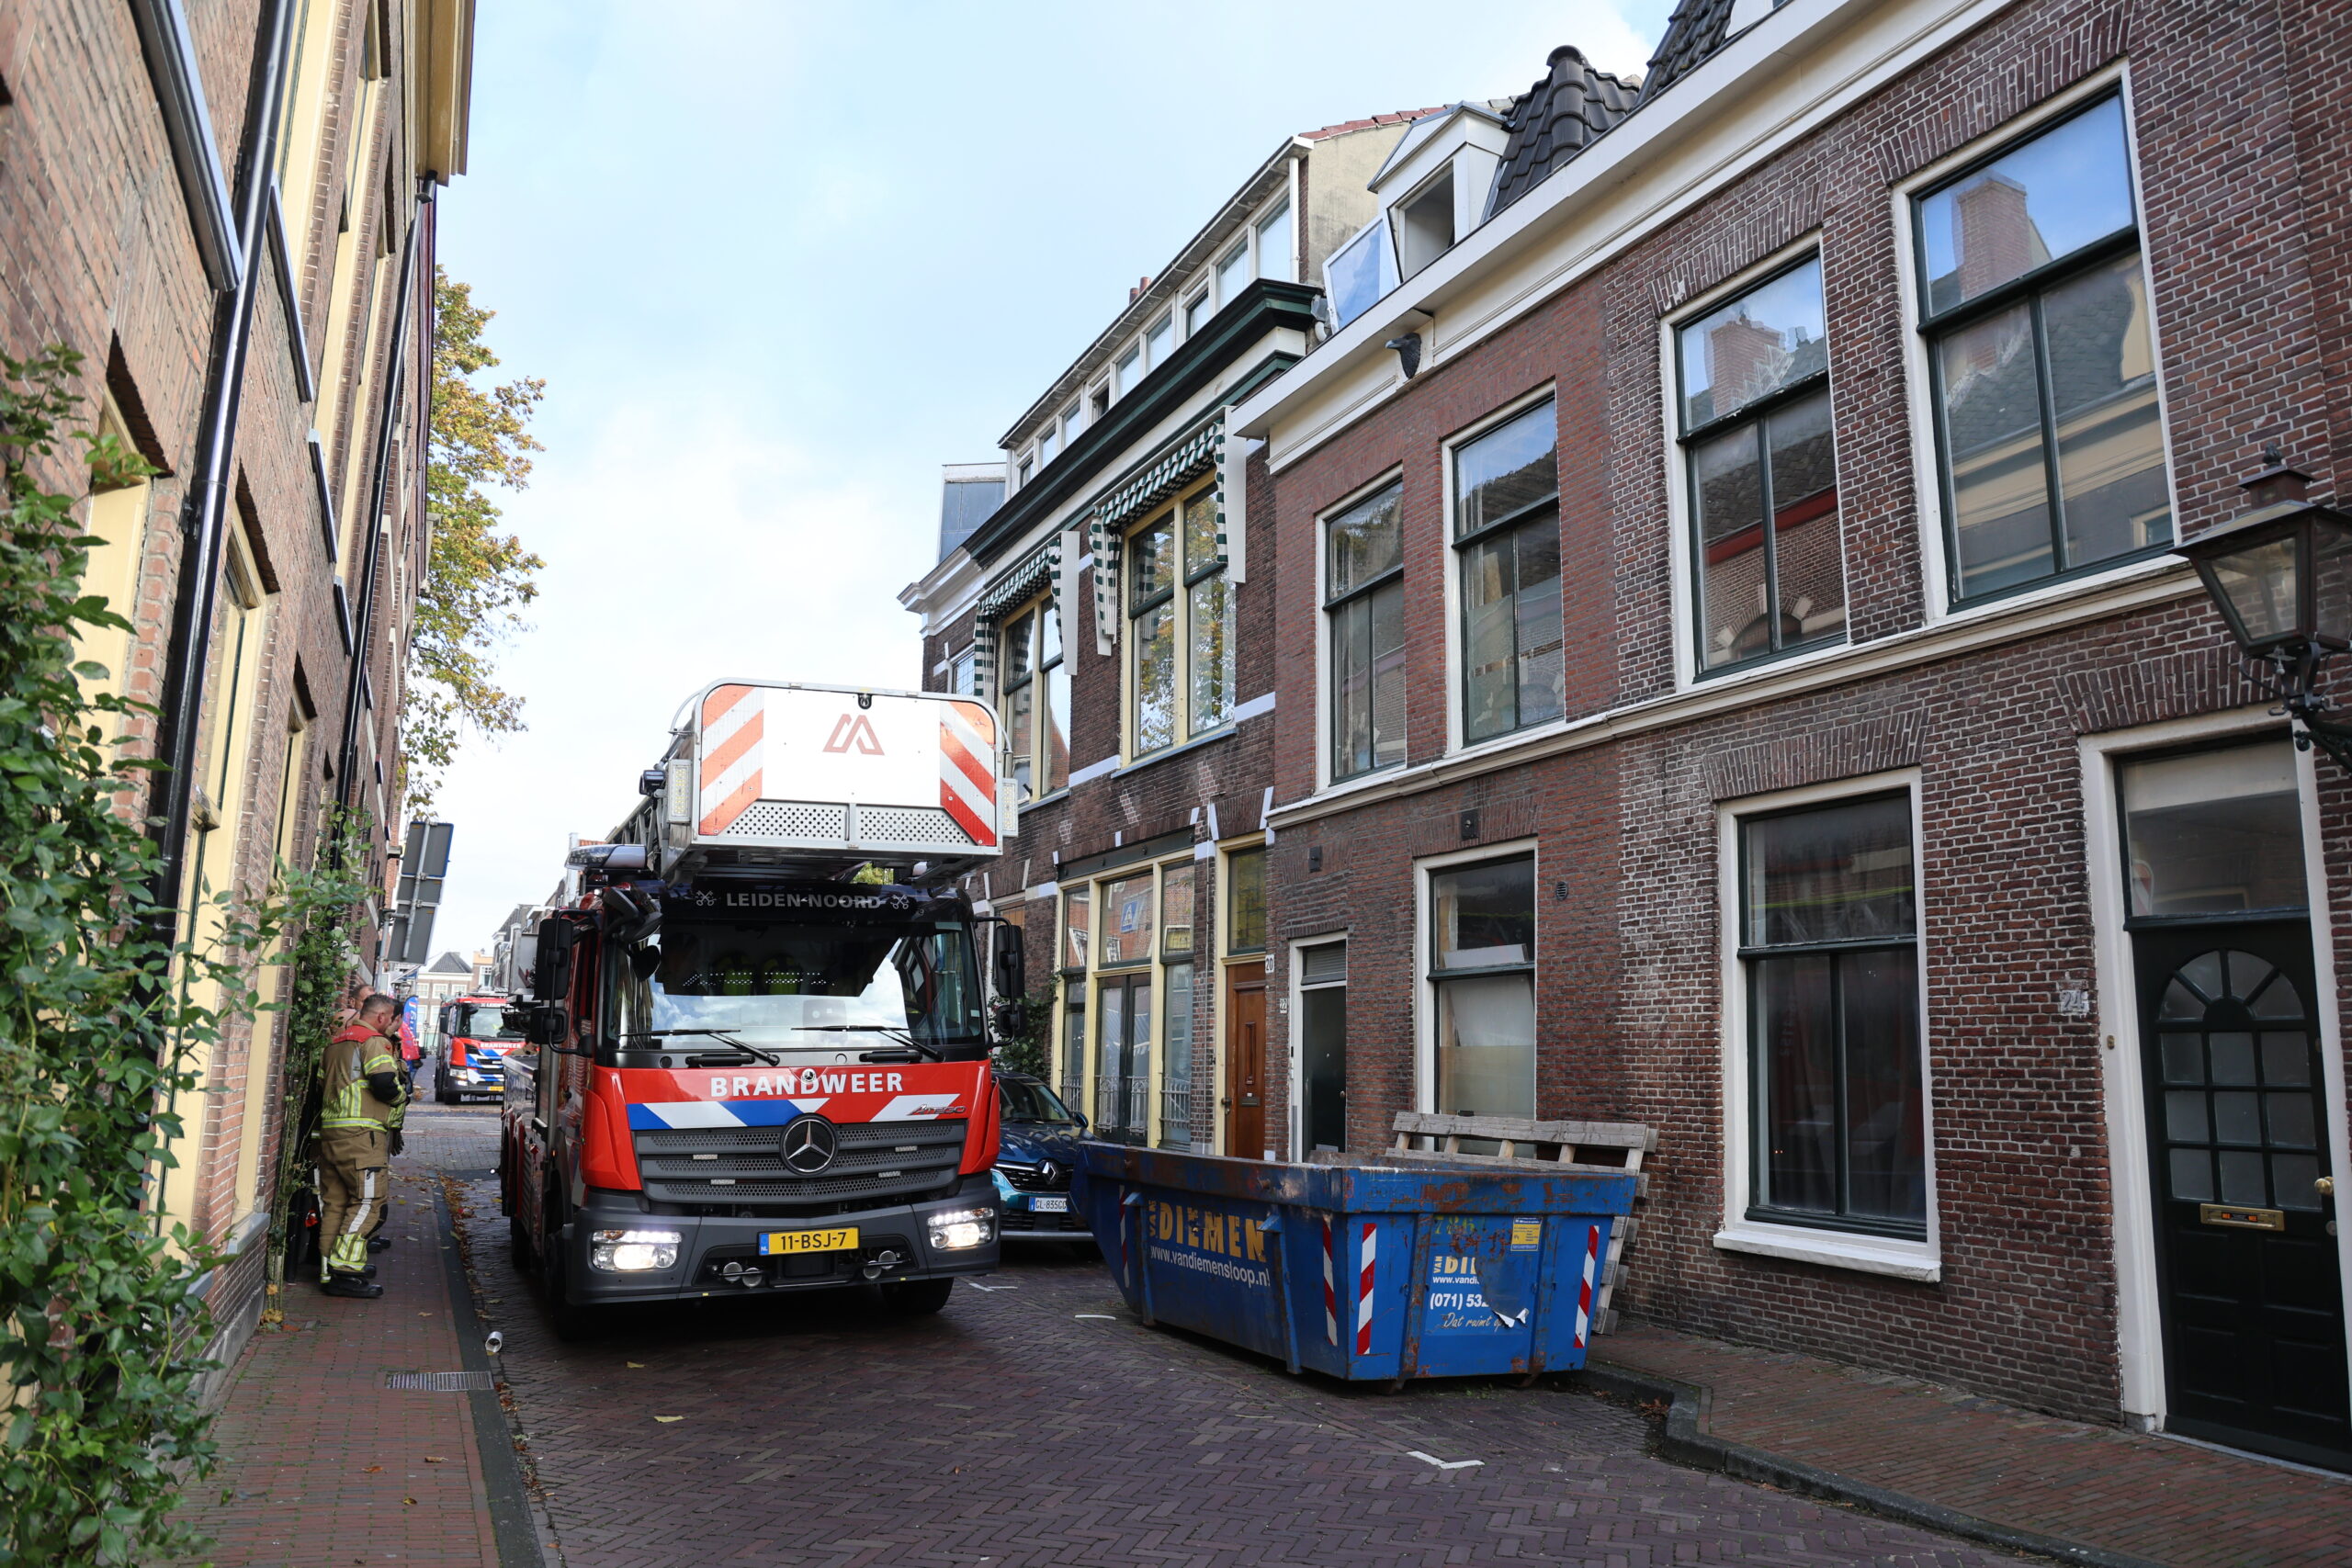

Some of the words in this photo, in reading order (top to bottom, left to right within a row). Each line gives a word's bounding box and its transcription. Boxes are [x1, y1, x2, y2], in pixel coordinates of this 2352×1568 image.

[1265, 958, 1273, 971] 20
[710, 1073, 903, 1097] BRANDWEER
[1159, 1201, 1267, 1262] DIEMEN
[781, 1232, 847, 1250] 11-BSJ-7
[1150, 1246, 1271, 1288] www.vandiemensloop.nl
[1433, 1256, 1442, 1273] VAN
[1430, 1293, 1463, 1310] (071)
[1443, 1312, 1464, 1328] Dat
